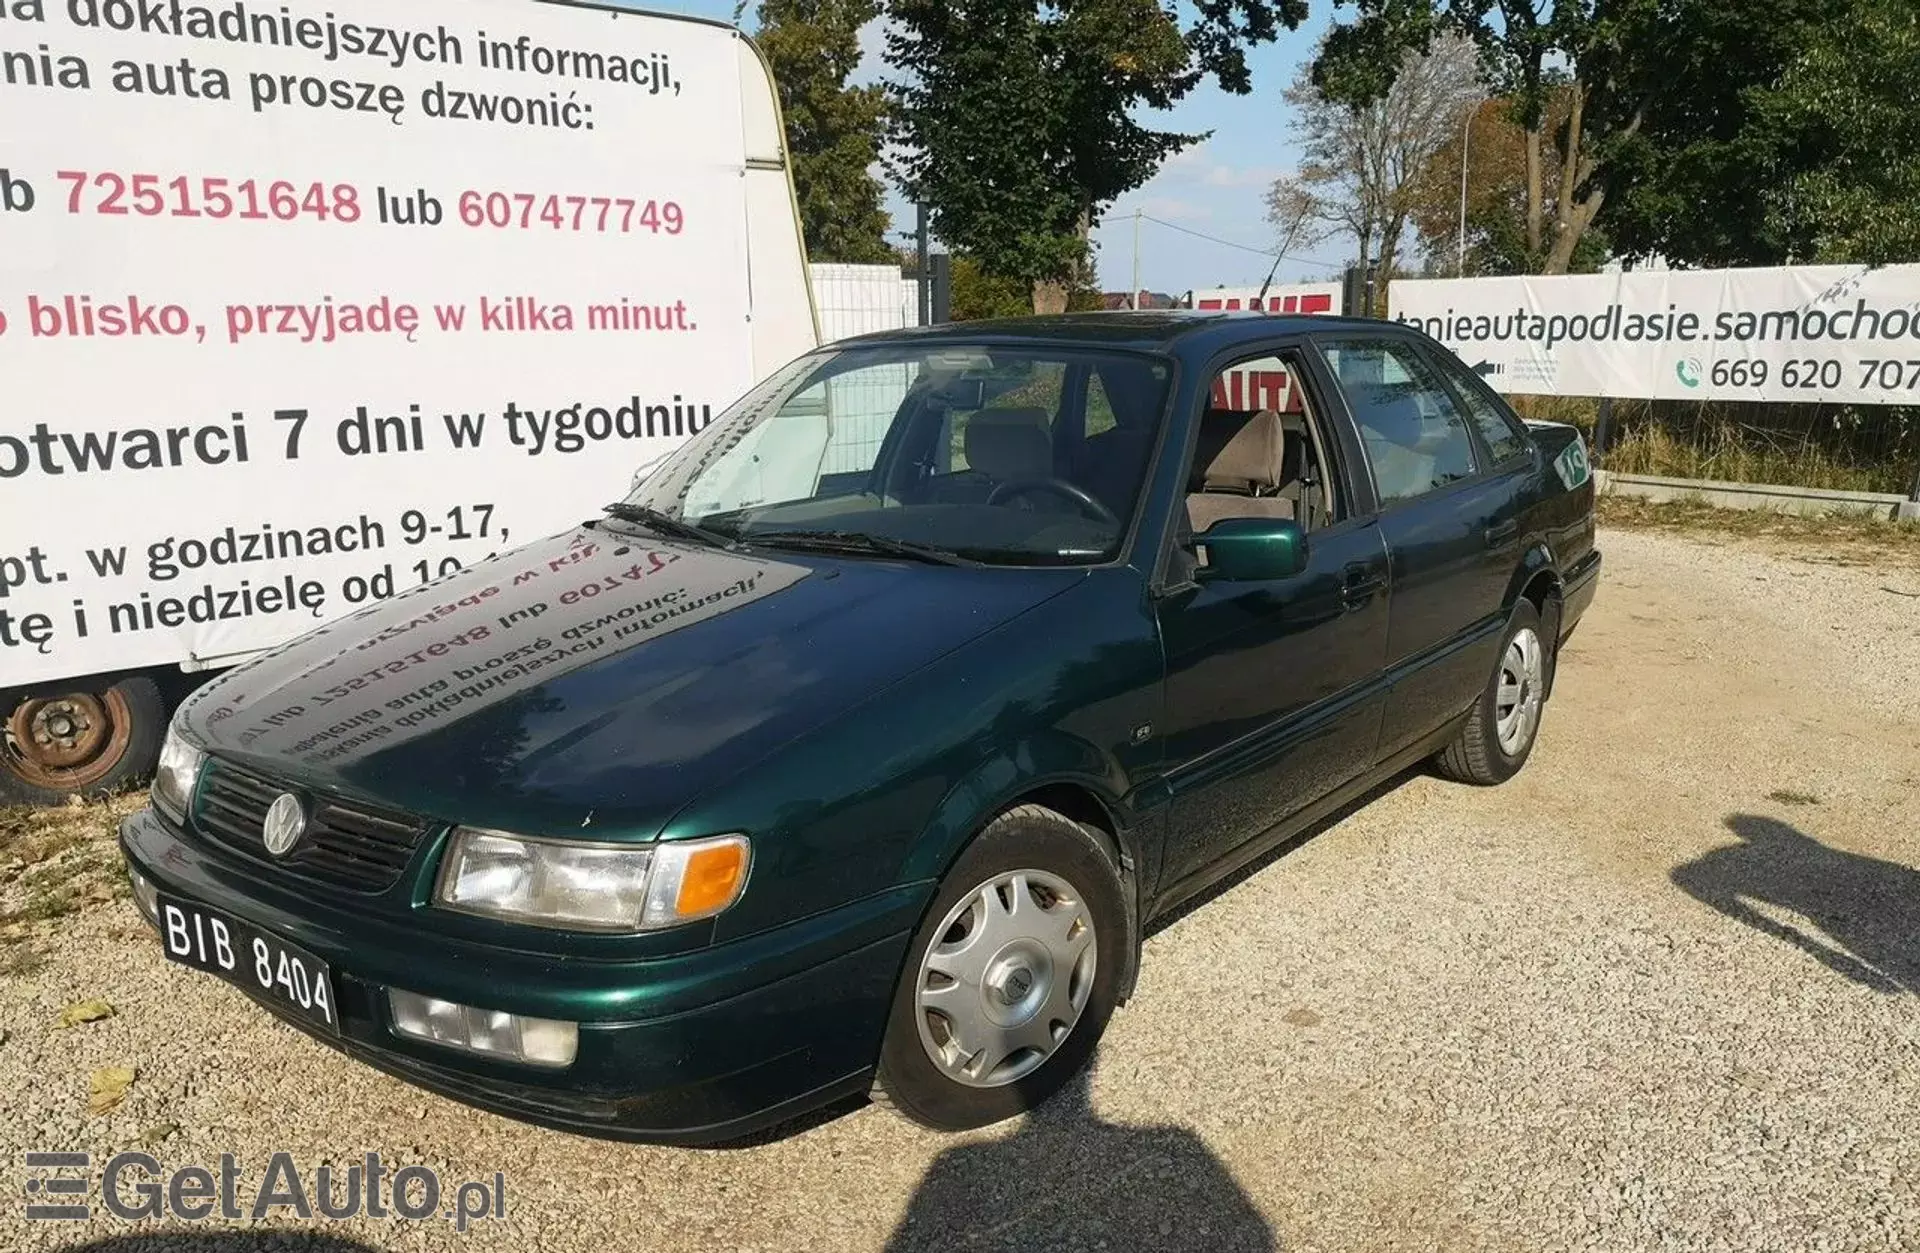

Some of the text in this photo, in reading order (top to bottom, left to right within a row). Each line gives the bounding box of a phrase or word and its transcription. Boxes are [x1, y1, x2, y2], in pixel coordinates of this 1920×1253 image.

[3, 44, 595, 130] nia auta proszę dzwonić:
[477, 31, 682, 95] informacji,
[57, 171, 361, 222] 725151648
[377, 187, 443, 226] lub
[458, 191, 684, 235] 607477749
[28, 295, 207, 343] blisko,
[226, 296, 419, 344] przyjadę
[434, 305, 465, 331] w
[480, 296, 573, 331] kilka
[588, 297, 697, 331] minut.
[1711, 358, 1920, 391] 669 620 707
[0, 411, 249, 478] otwarci
[273, 408, 309, 460] 7
[336, 404, 424, 456] dni
[442, 413, 486, 449] w
[502, 395, 711, 455] tygodniu
[85, 547, 127, 578] w
[147, 514, 386, 581] godzinach
[400, 503, 511, 543] 9-17,
[73, 599, 88, 637] i
[109, 574, 326, 638] niedzielę
[342, 563, 395, 603] od
[165, 904, 332, 1025] BIB 8404
